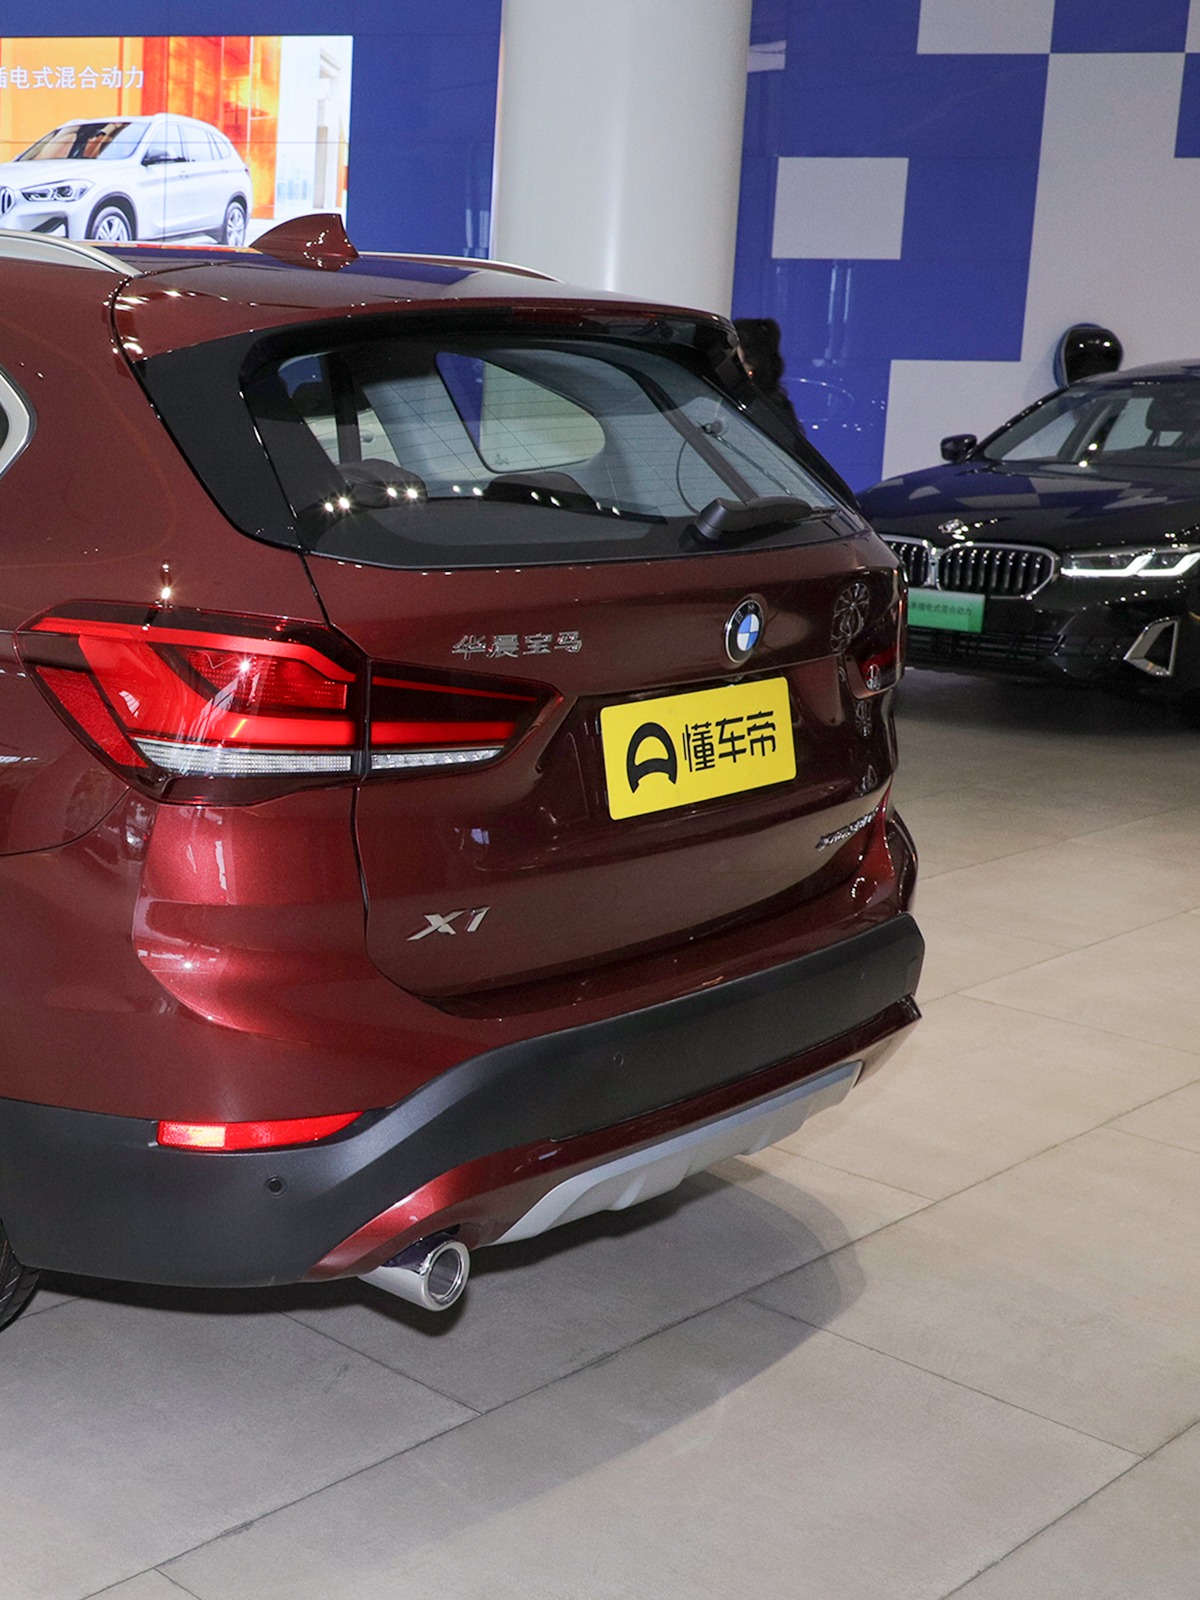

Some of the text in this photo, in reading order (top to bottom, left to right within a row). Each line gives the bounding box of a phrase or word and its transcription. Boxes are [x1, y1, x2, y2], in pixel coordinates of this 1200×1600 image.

[452, 631, 583, 660] 华晨宝马
[682, 711, 777, 773] 懂车帝
[407, 907, 490, 941] X1
